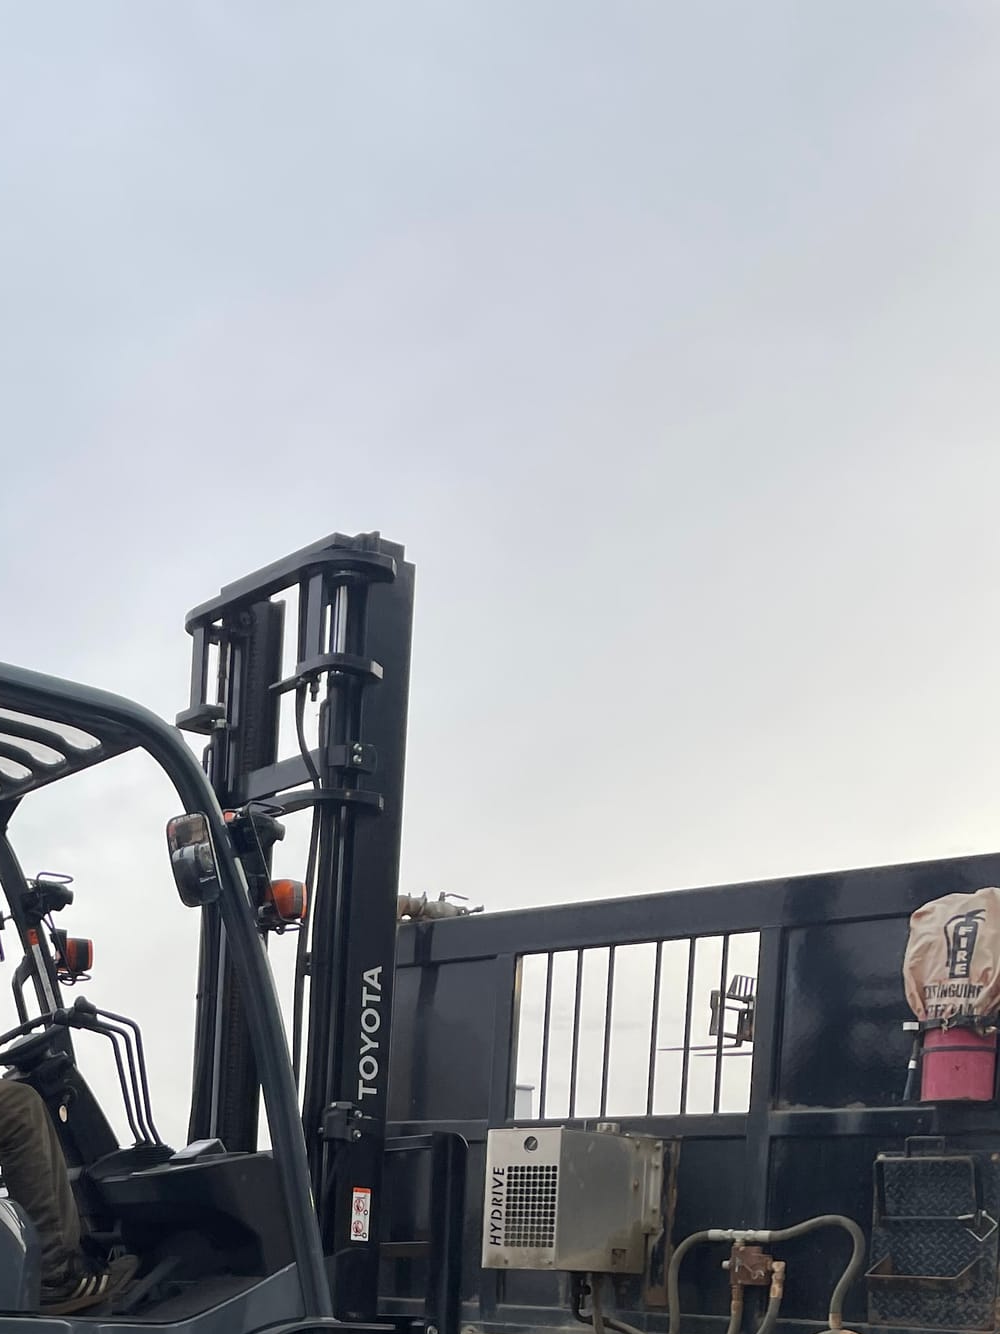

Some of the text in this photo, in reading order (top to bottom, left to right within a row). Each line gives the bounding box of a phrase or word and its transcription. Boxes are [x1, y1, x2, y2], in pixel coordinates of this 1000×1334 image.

[954, 926, 974, 976] FIRE
[358, 966, 383, 1100] TOYOTA
[490, 1166, 505, 1246] HYDRIVE
